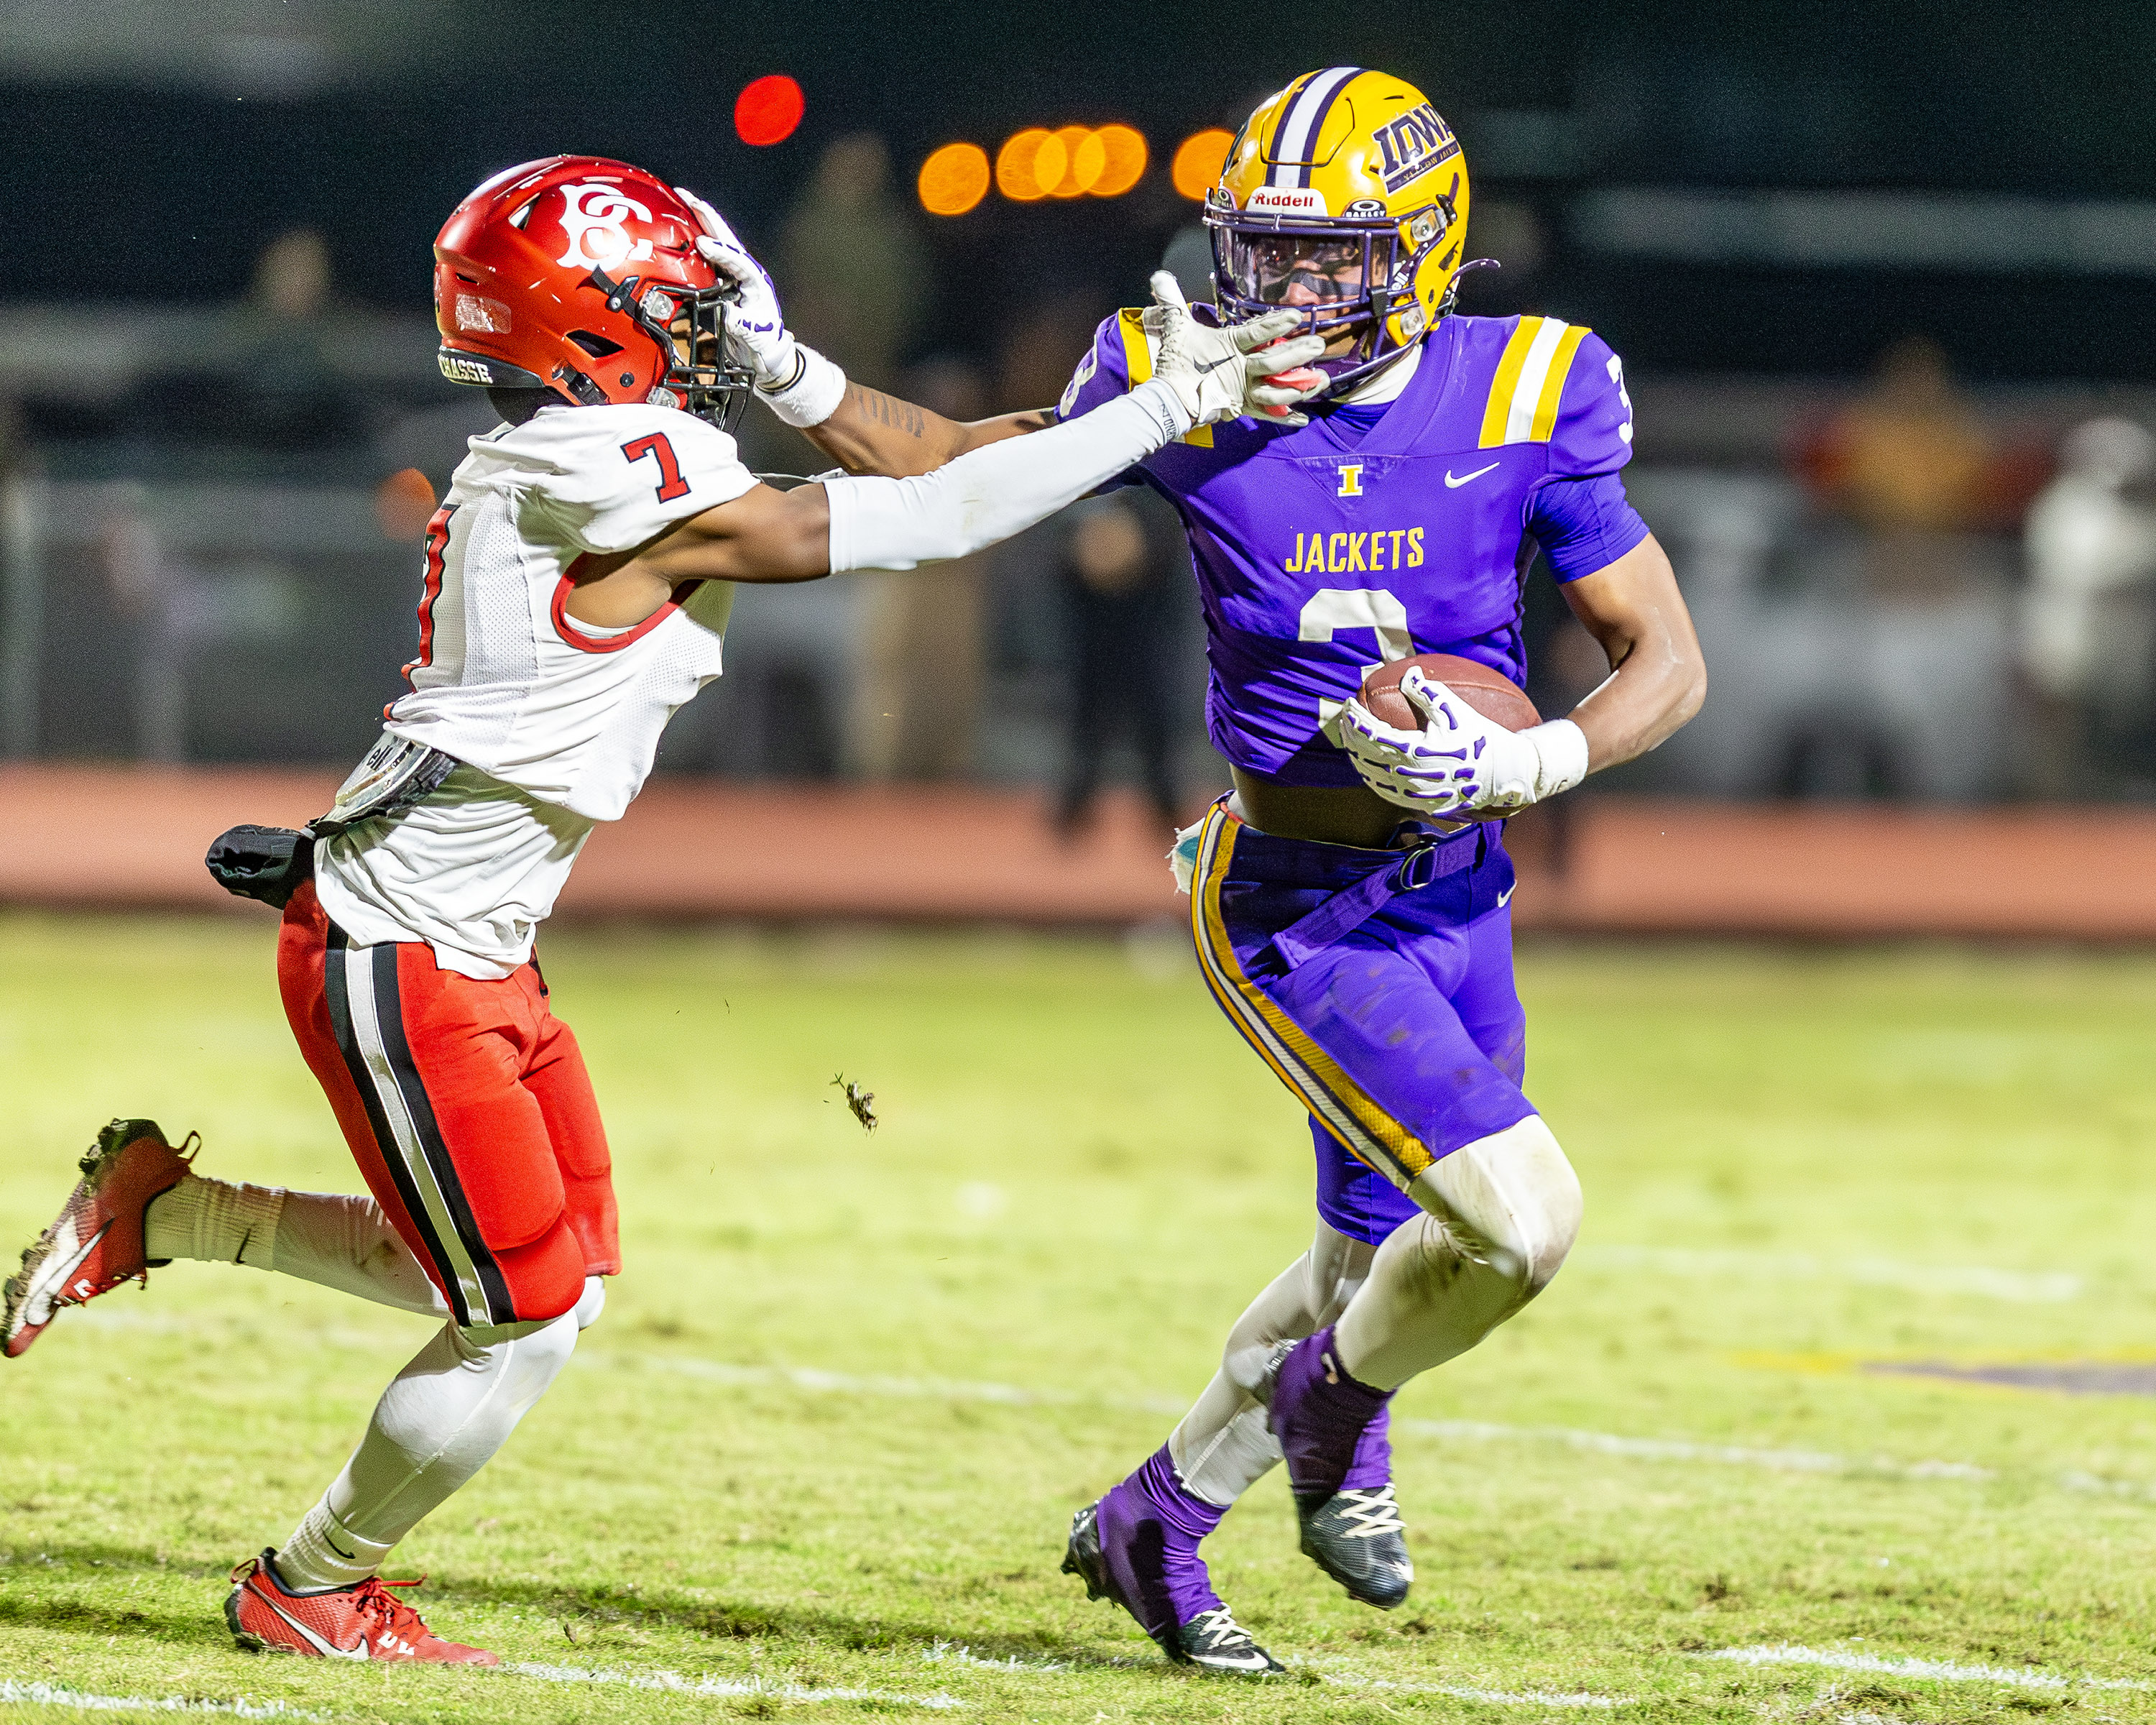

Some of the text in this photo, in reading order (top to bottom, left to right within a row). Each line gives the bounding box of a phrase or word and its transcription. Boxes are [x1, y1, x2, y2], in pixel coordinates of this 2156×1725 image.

[1255, 193, 1314, 207] Riddell
[619, 431, 692, 504] 7
[1337, 464, 1364, 497] I
[1285, 526, 1424, 574] JACKETS
